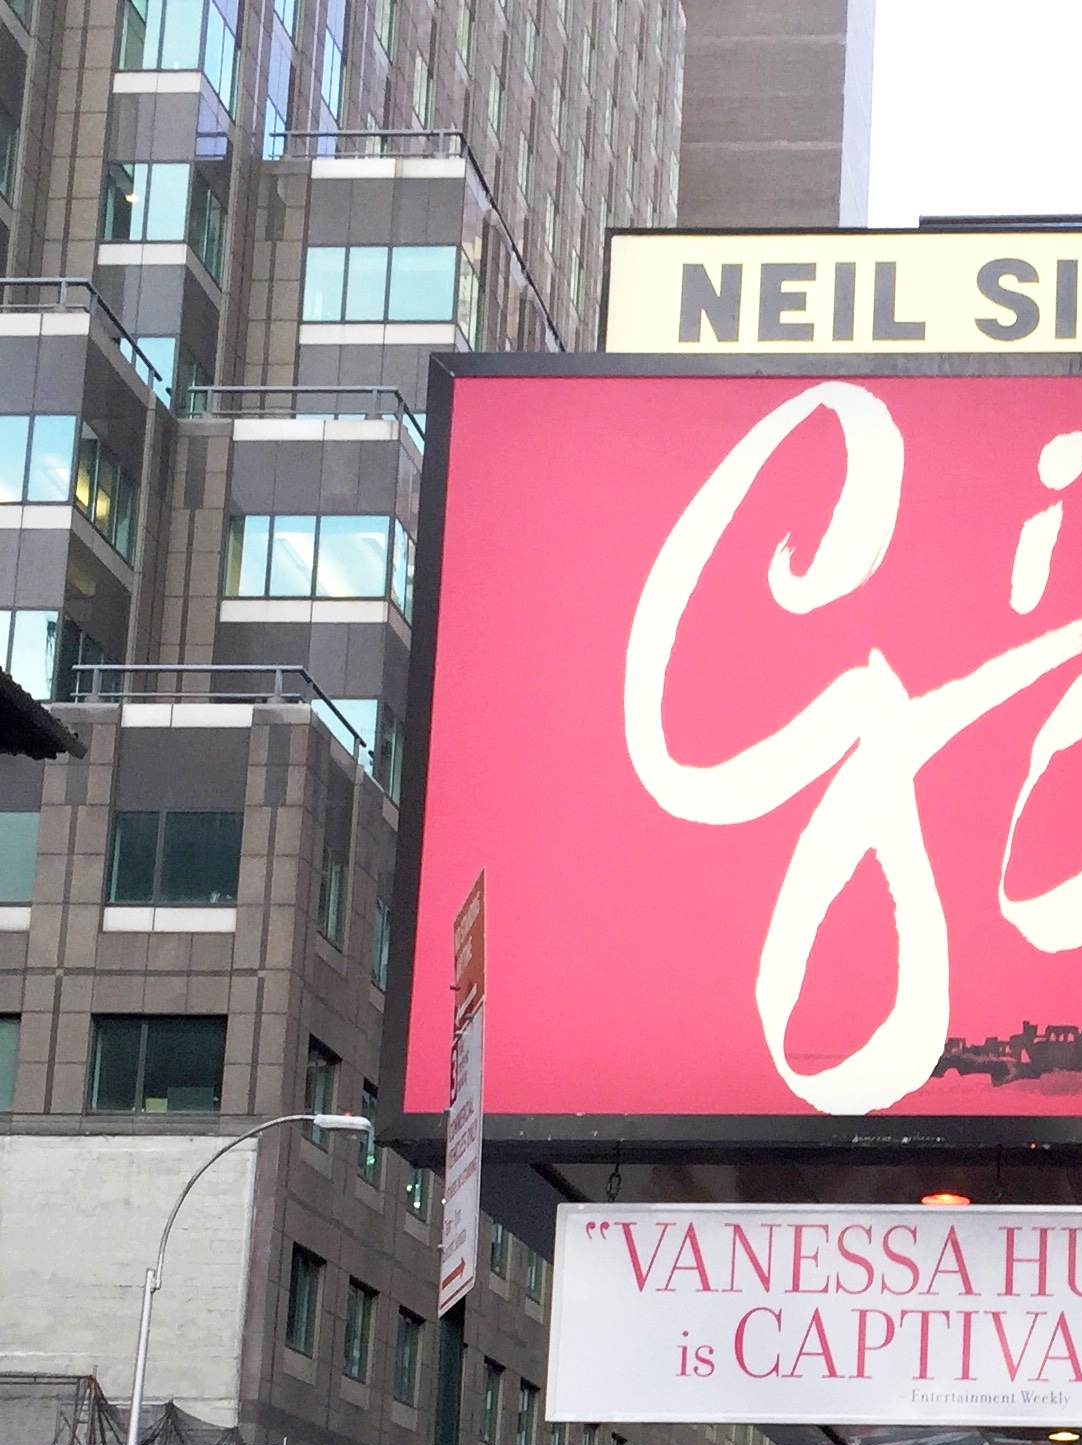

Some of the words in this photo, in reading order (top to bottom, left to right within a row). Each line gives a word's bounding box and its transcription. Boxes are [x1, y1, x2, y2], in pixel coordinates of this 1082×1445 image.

[677, 260, 927, 343] NEIL
[585, 1219, 977, 1297] “VANESSA
[676, 1329, 715, 1378] is
[911, 1388, 1016, 1405] Entertainment
[1021, 1389, 1072, 1409] Weekly
